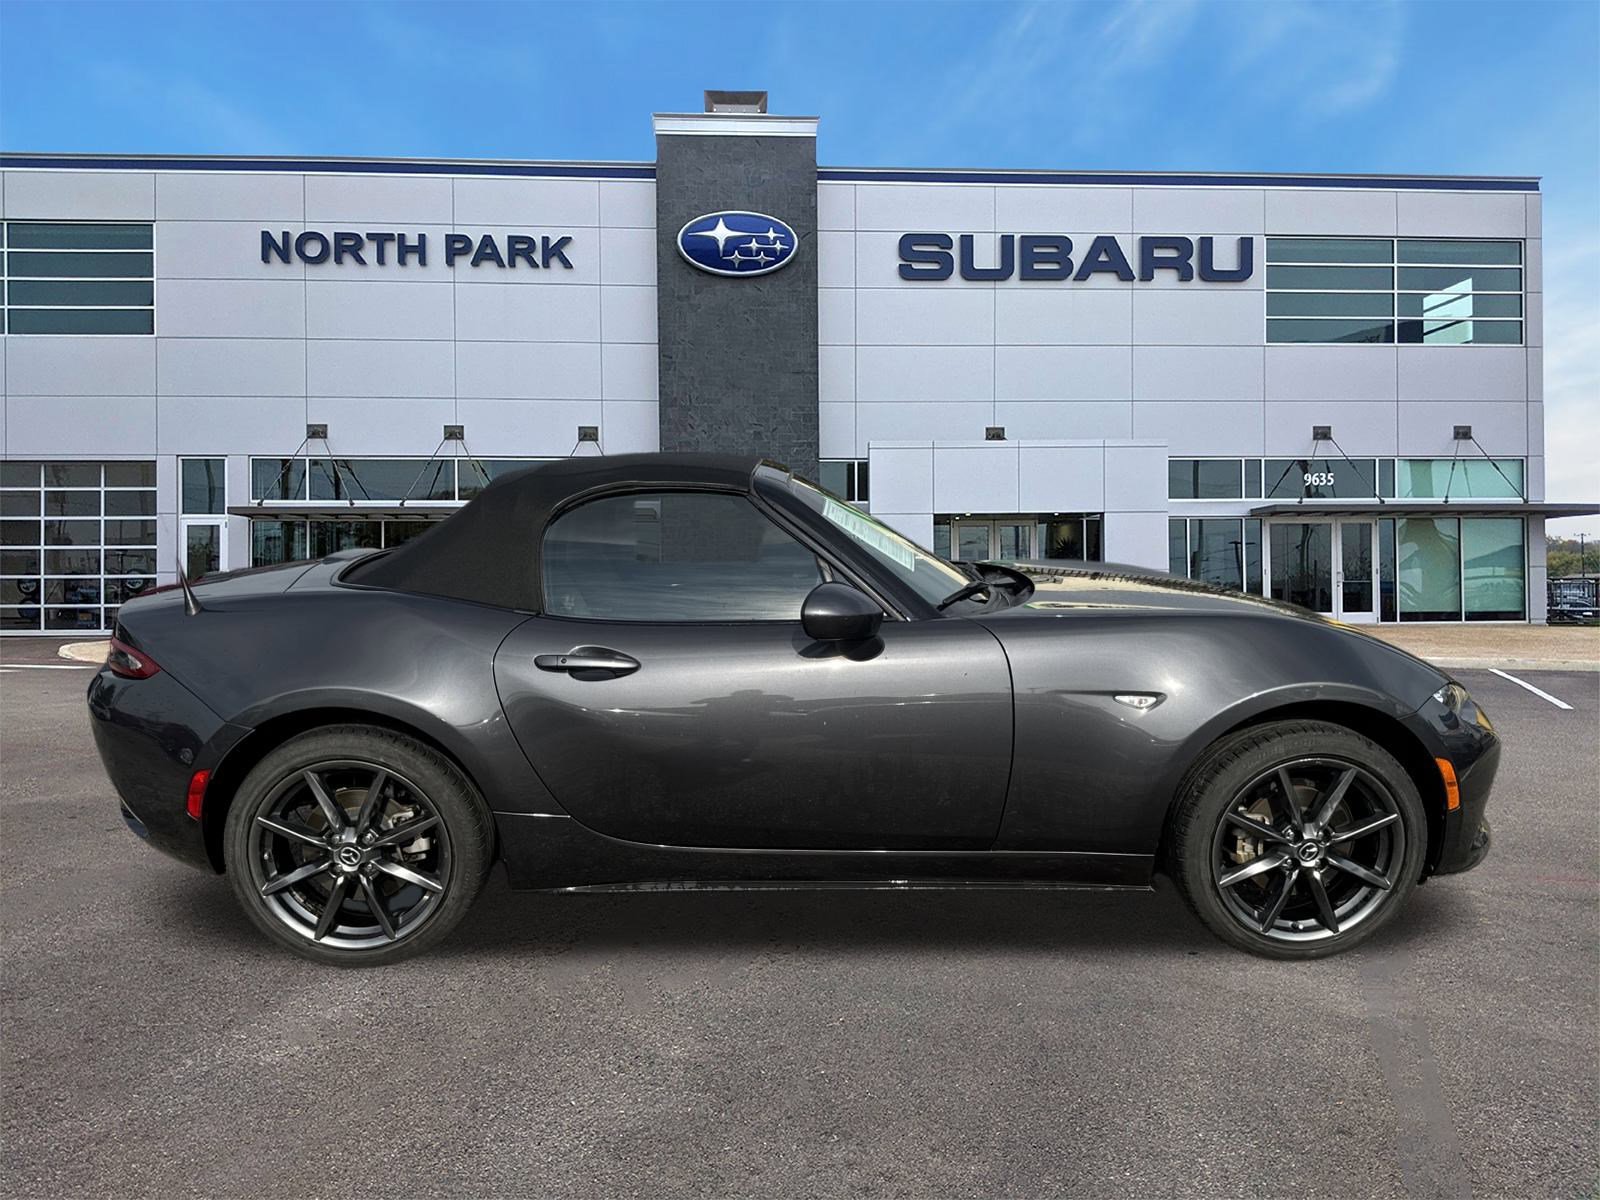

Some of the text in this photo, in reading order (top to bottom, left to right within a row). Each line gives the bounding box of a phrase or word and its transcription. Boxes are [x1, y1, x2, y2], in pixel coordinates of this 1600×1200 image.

[260, 230, 574, 269] NORTH PARK
[898, 233, 1254, 282] SUBARU
[1303, 472, 1335, 486] 9635
